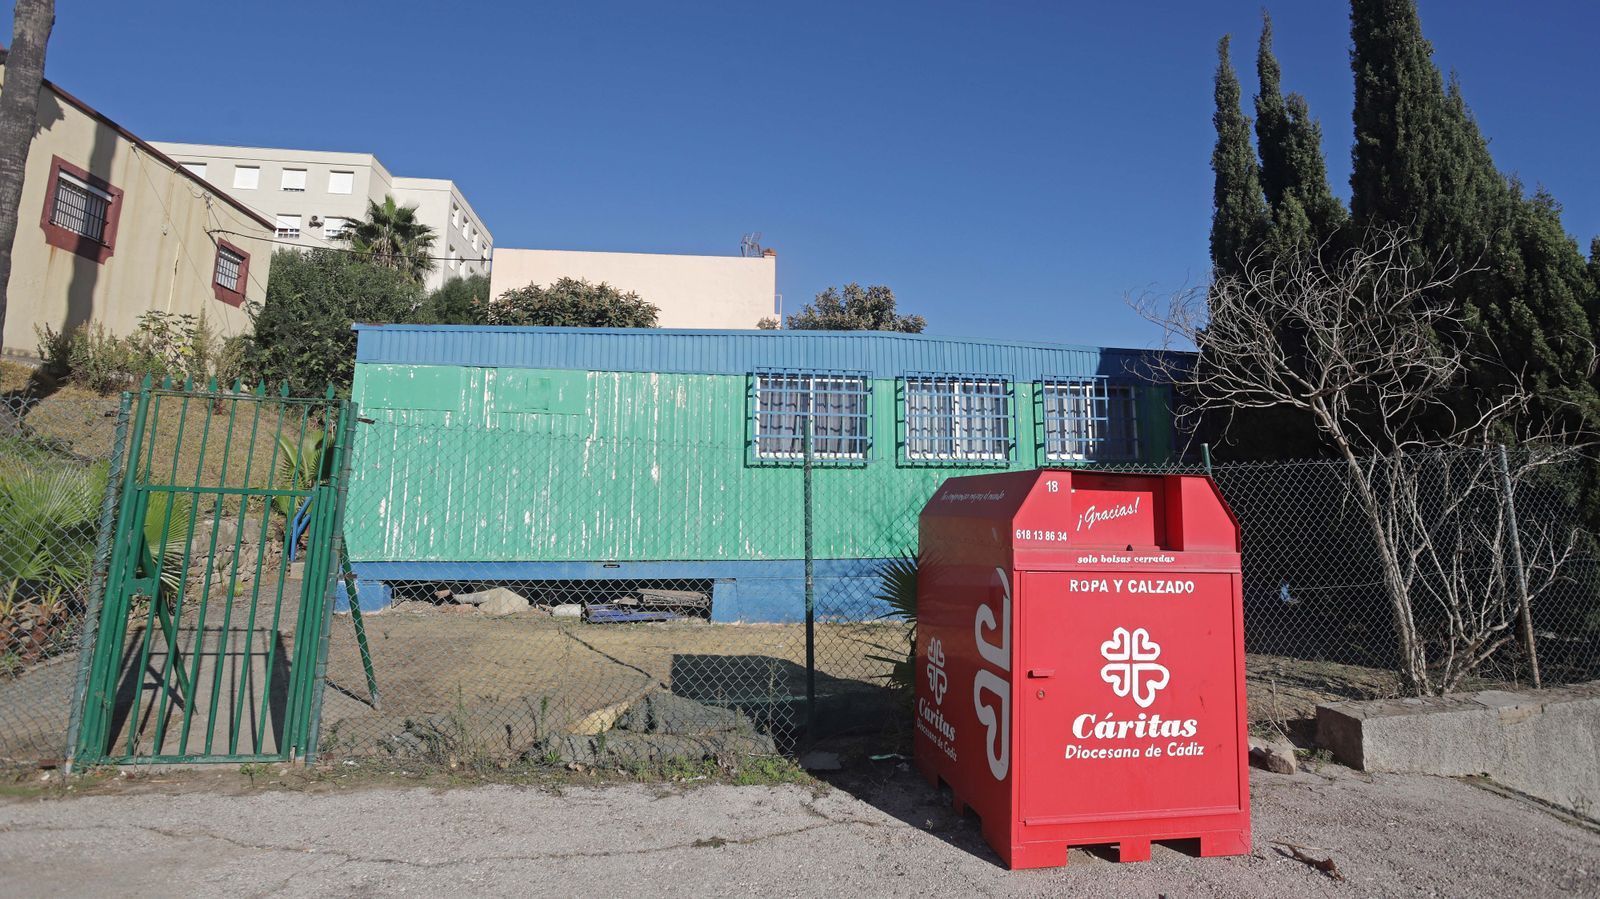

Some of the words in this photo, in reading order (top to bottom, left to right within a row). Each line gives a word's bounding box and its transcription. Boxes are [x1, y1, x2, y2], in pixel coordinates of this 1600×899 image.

[1046, 480, 1059, 493] 18
[1076, 496, 1140, 531] ¡Gracias!
[1016, 529, 1031, 540] 618
[1033, 530, 1043, 541] 13
[1045, 531, 1055, 541] 86
[1057, 531, 1067, 541] 34
[1077, 554, 1098, 564] solo
[1100, 554, 1131, 564] bolsas
[1133, 555, 1175, 564] cerradas
[1070, 579, 1108, 593] ROPA
[1113, 579, 1124, 593] Y
[1127, 580, 1195, 594] CALZADO
[918, 697, 956, 742] Cáritas
[1072, 712, 1198, 739] Cáritas
[1065, 744, 1140, 759] Diocesana
[1144, 743, 1162, 758] de
[1167, 741, 1205, 757] Cádiz
